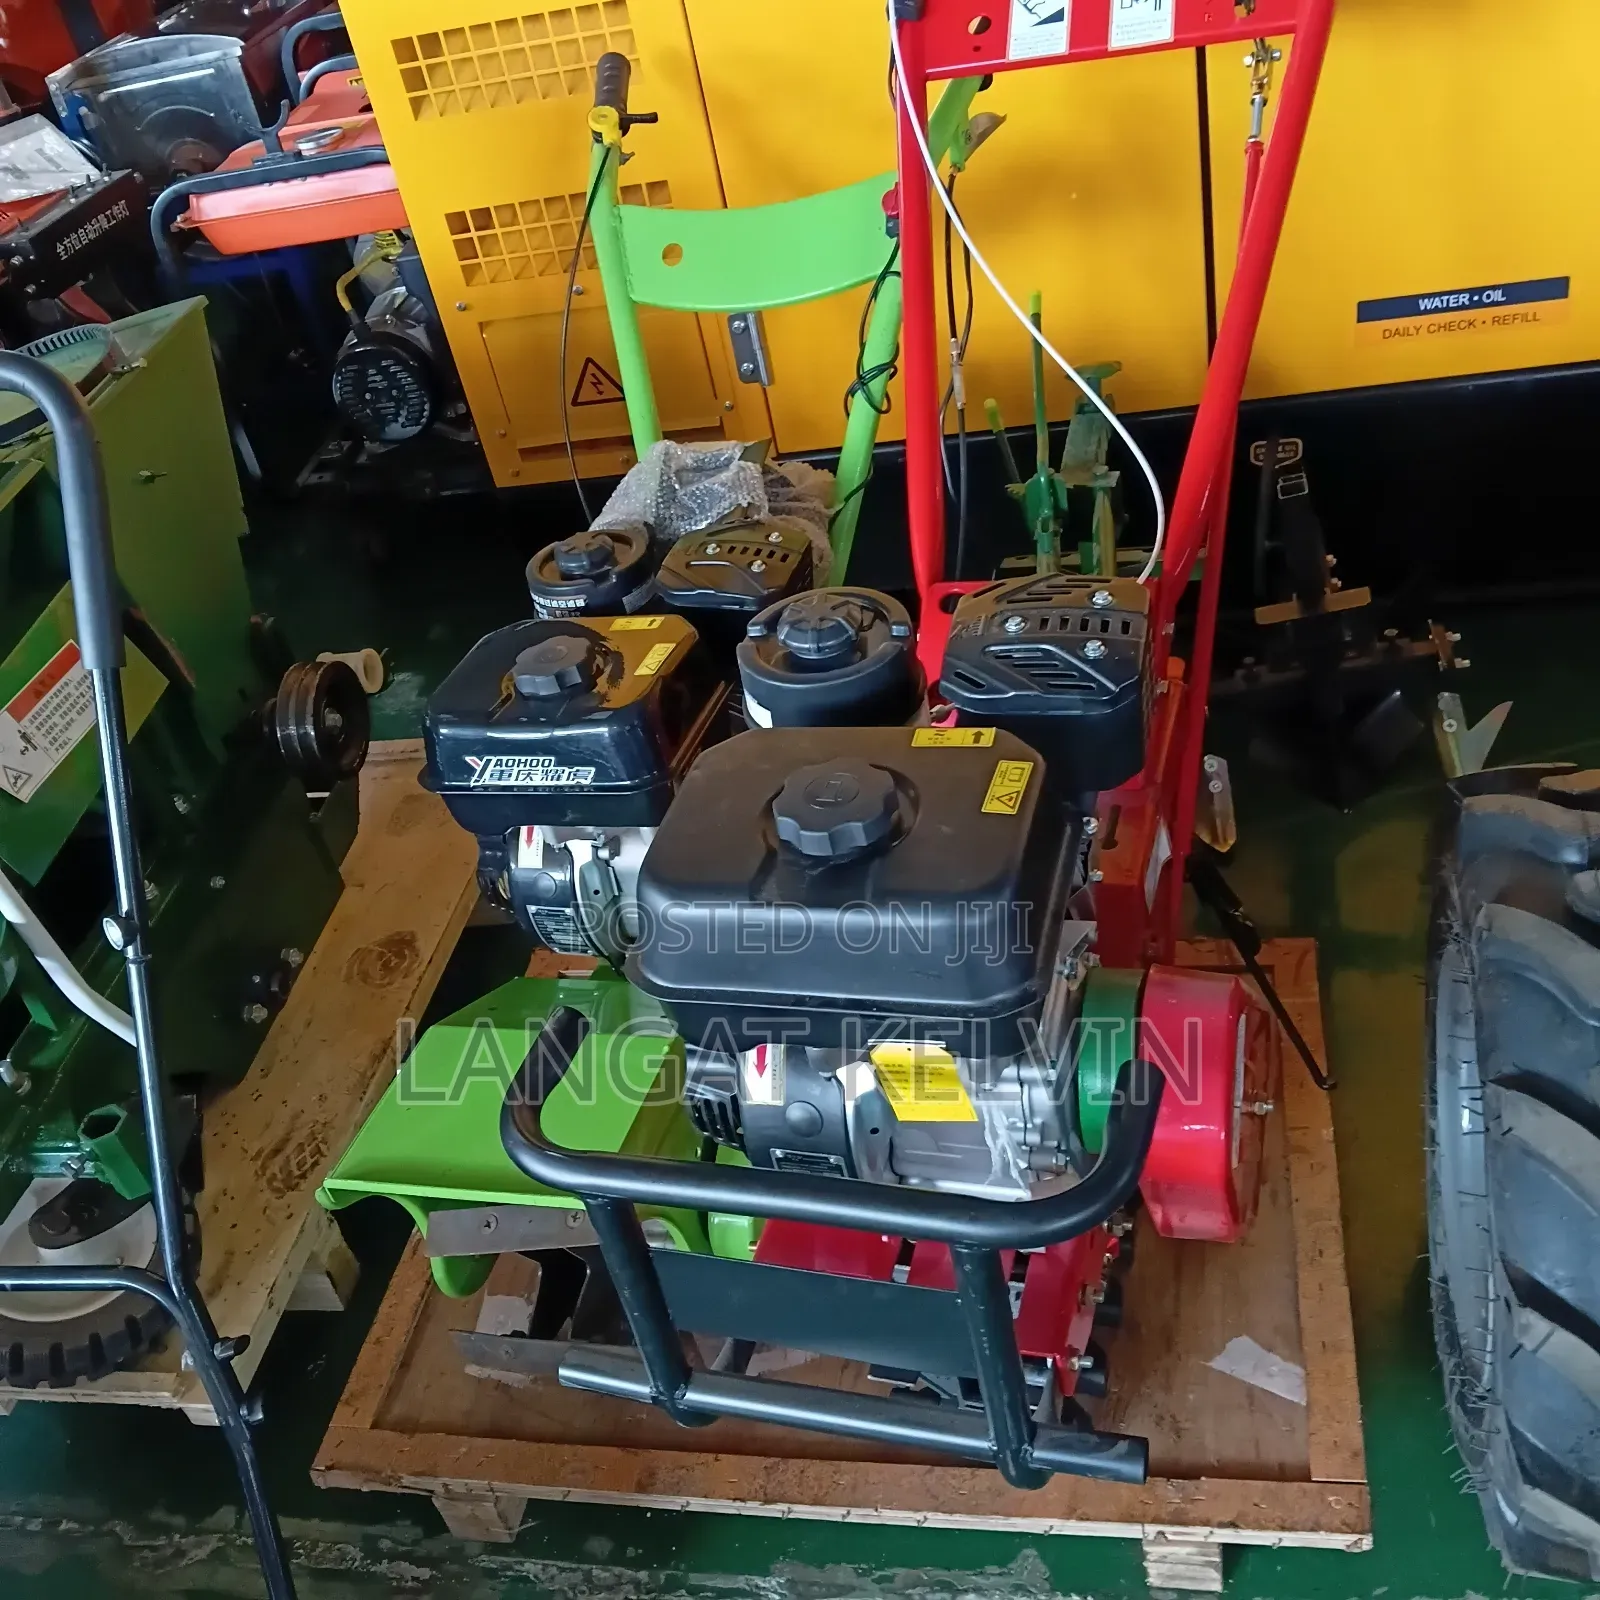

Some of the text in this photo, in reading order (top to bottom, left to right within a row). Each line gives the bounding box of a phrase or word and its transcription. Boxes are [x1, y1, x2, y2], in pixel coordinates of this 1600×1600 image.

[1418, 288, 1507, 311] WATER OIL
[1382, 311, 1541, 340] DAILY CHECK REFILL
[465, 757, 554, 784] YAOHOO
[487, 768, 592, 783] 重庆耀虎
